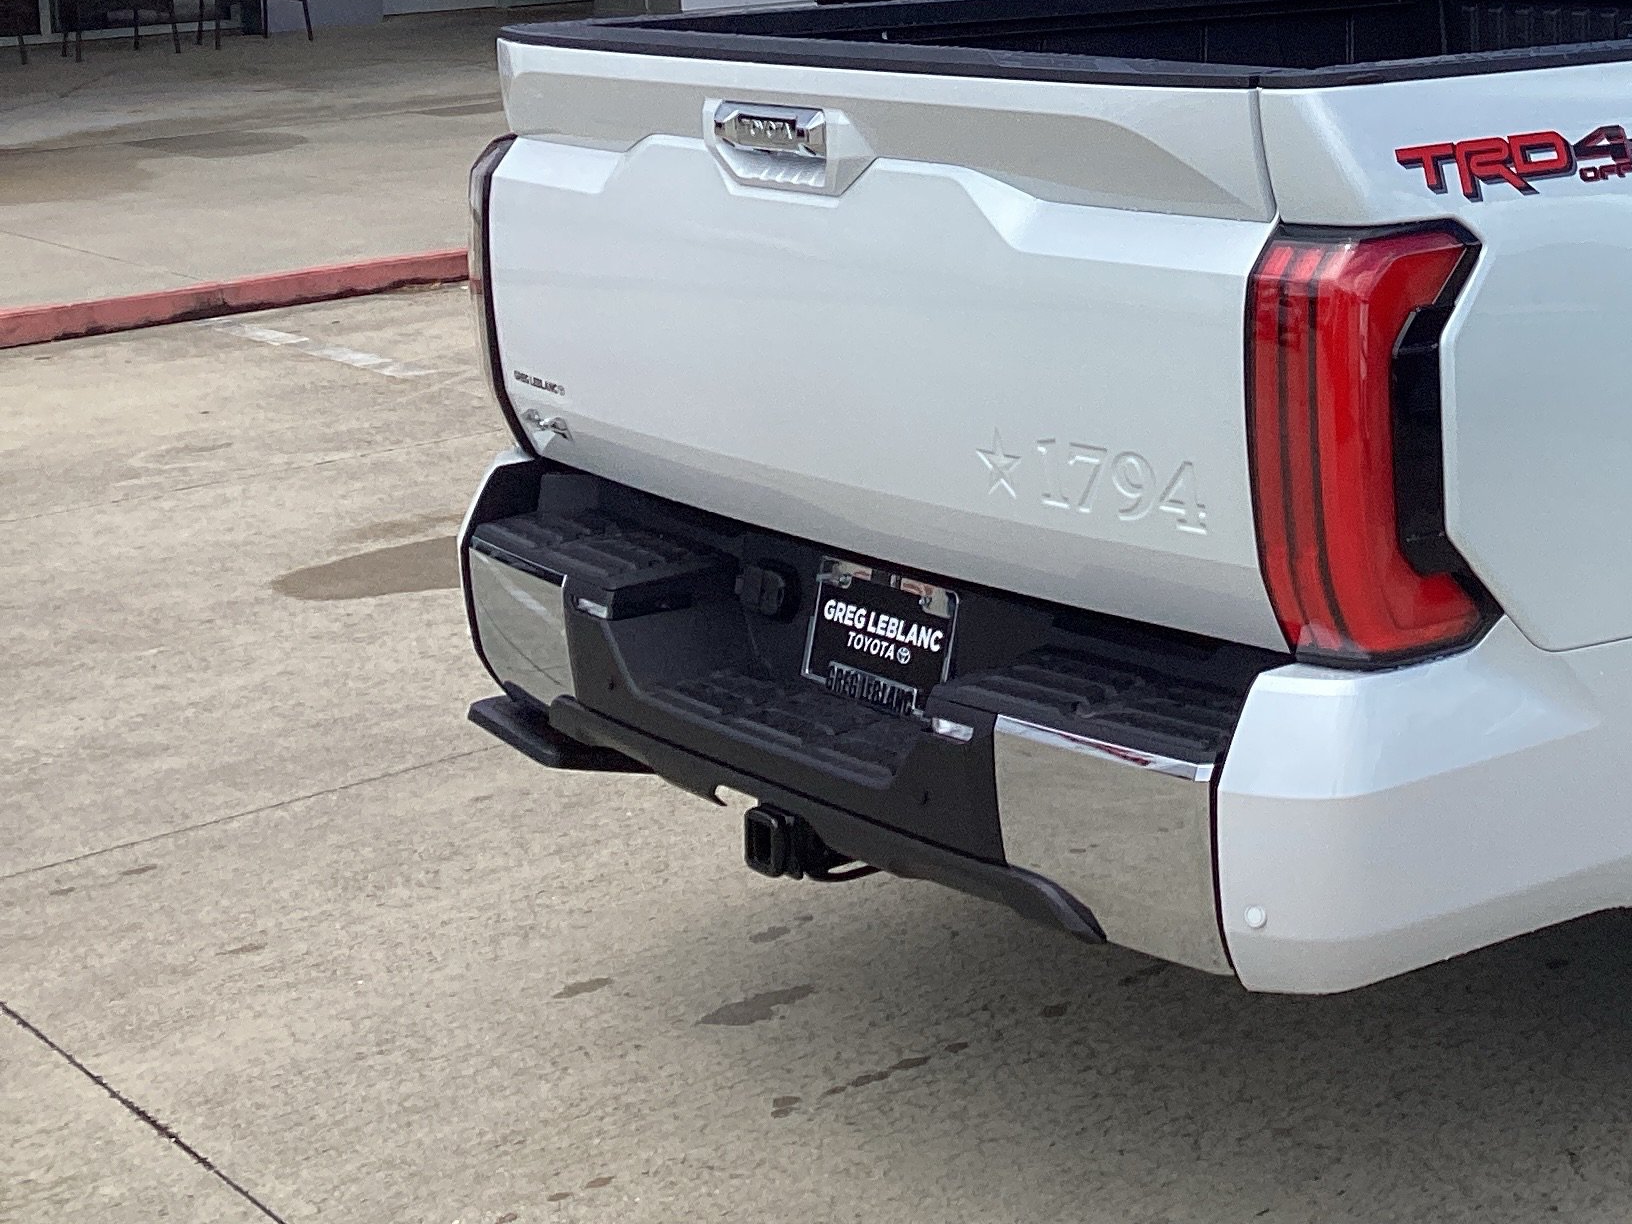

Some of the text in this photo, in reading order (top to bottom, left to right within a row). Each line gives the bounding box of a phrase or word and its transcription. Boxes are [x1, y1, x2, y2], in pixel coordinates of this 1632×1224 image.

[1395, 131, 1577, 202] TRD
[1036, 438, 1207, 535] 1794
[823, 599, 944, 652] GREG LEBLANC
[847, 631, 896, 660] TOYOTA
